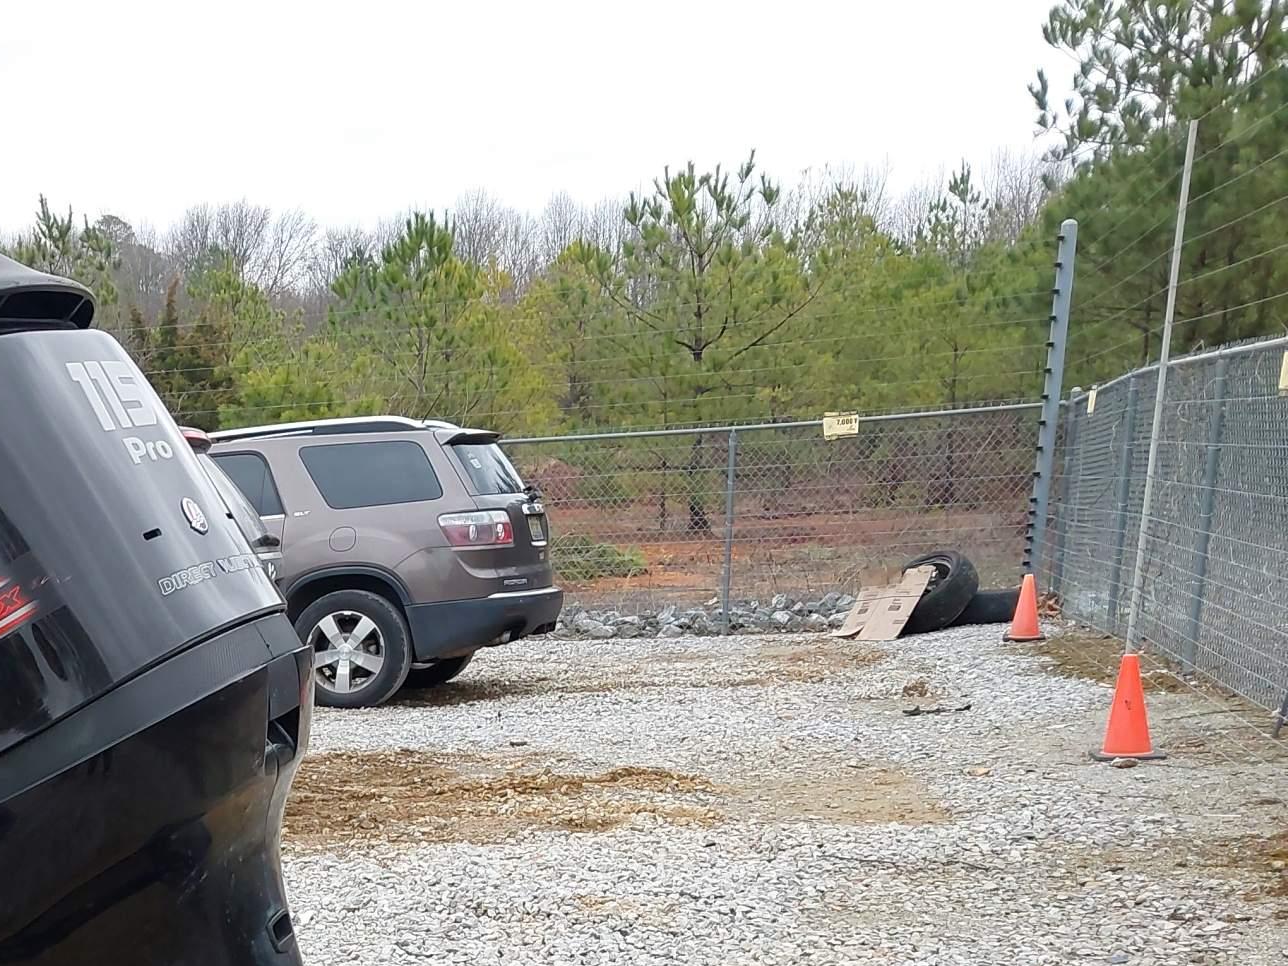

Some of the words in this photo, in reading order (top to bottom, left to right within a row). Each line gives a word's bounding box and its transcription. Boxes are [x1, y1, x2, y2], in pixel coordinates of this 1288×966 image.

[65, 360, 158, 432] 115
[122, 436, 174, 466] Pro
[158, 561, 217, 596] DIRECT
